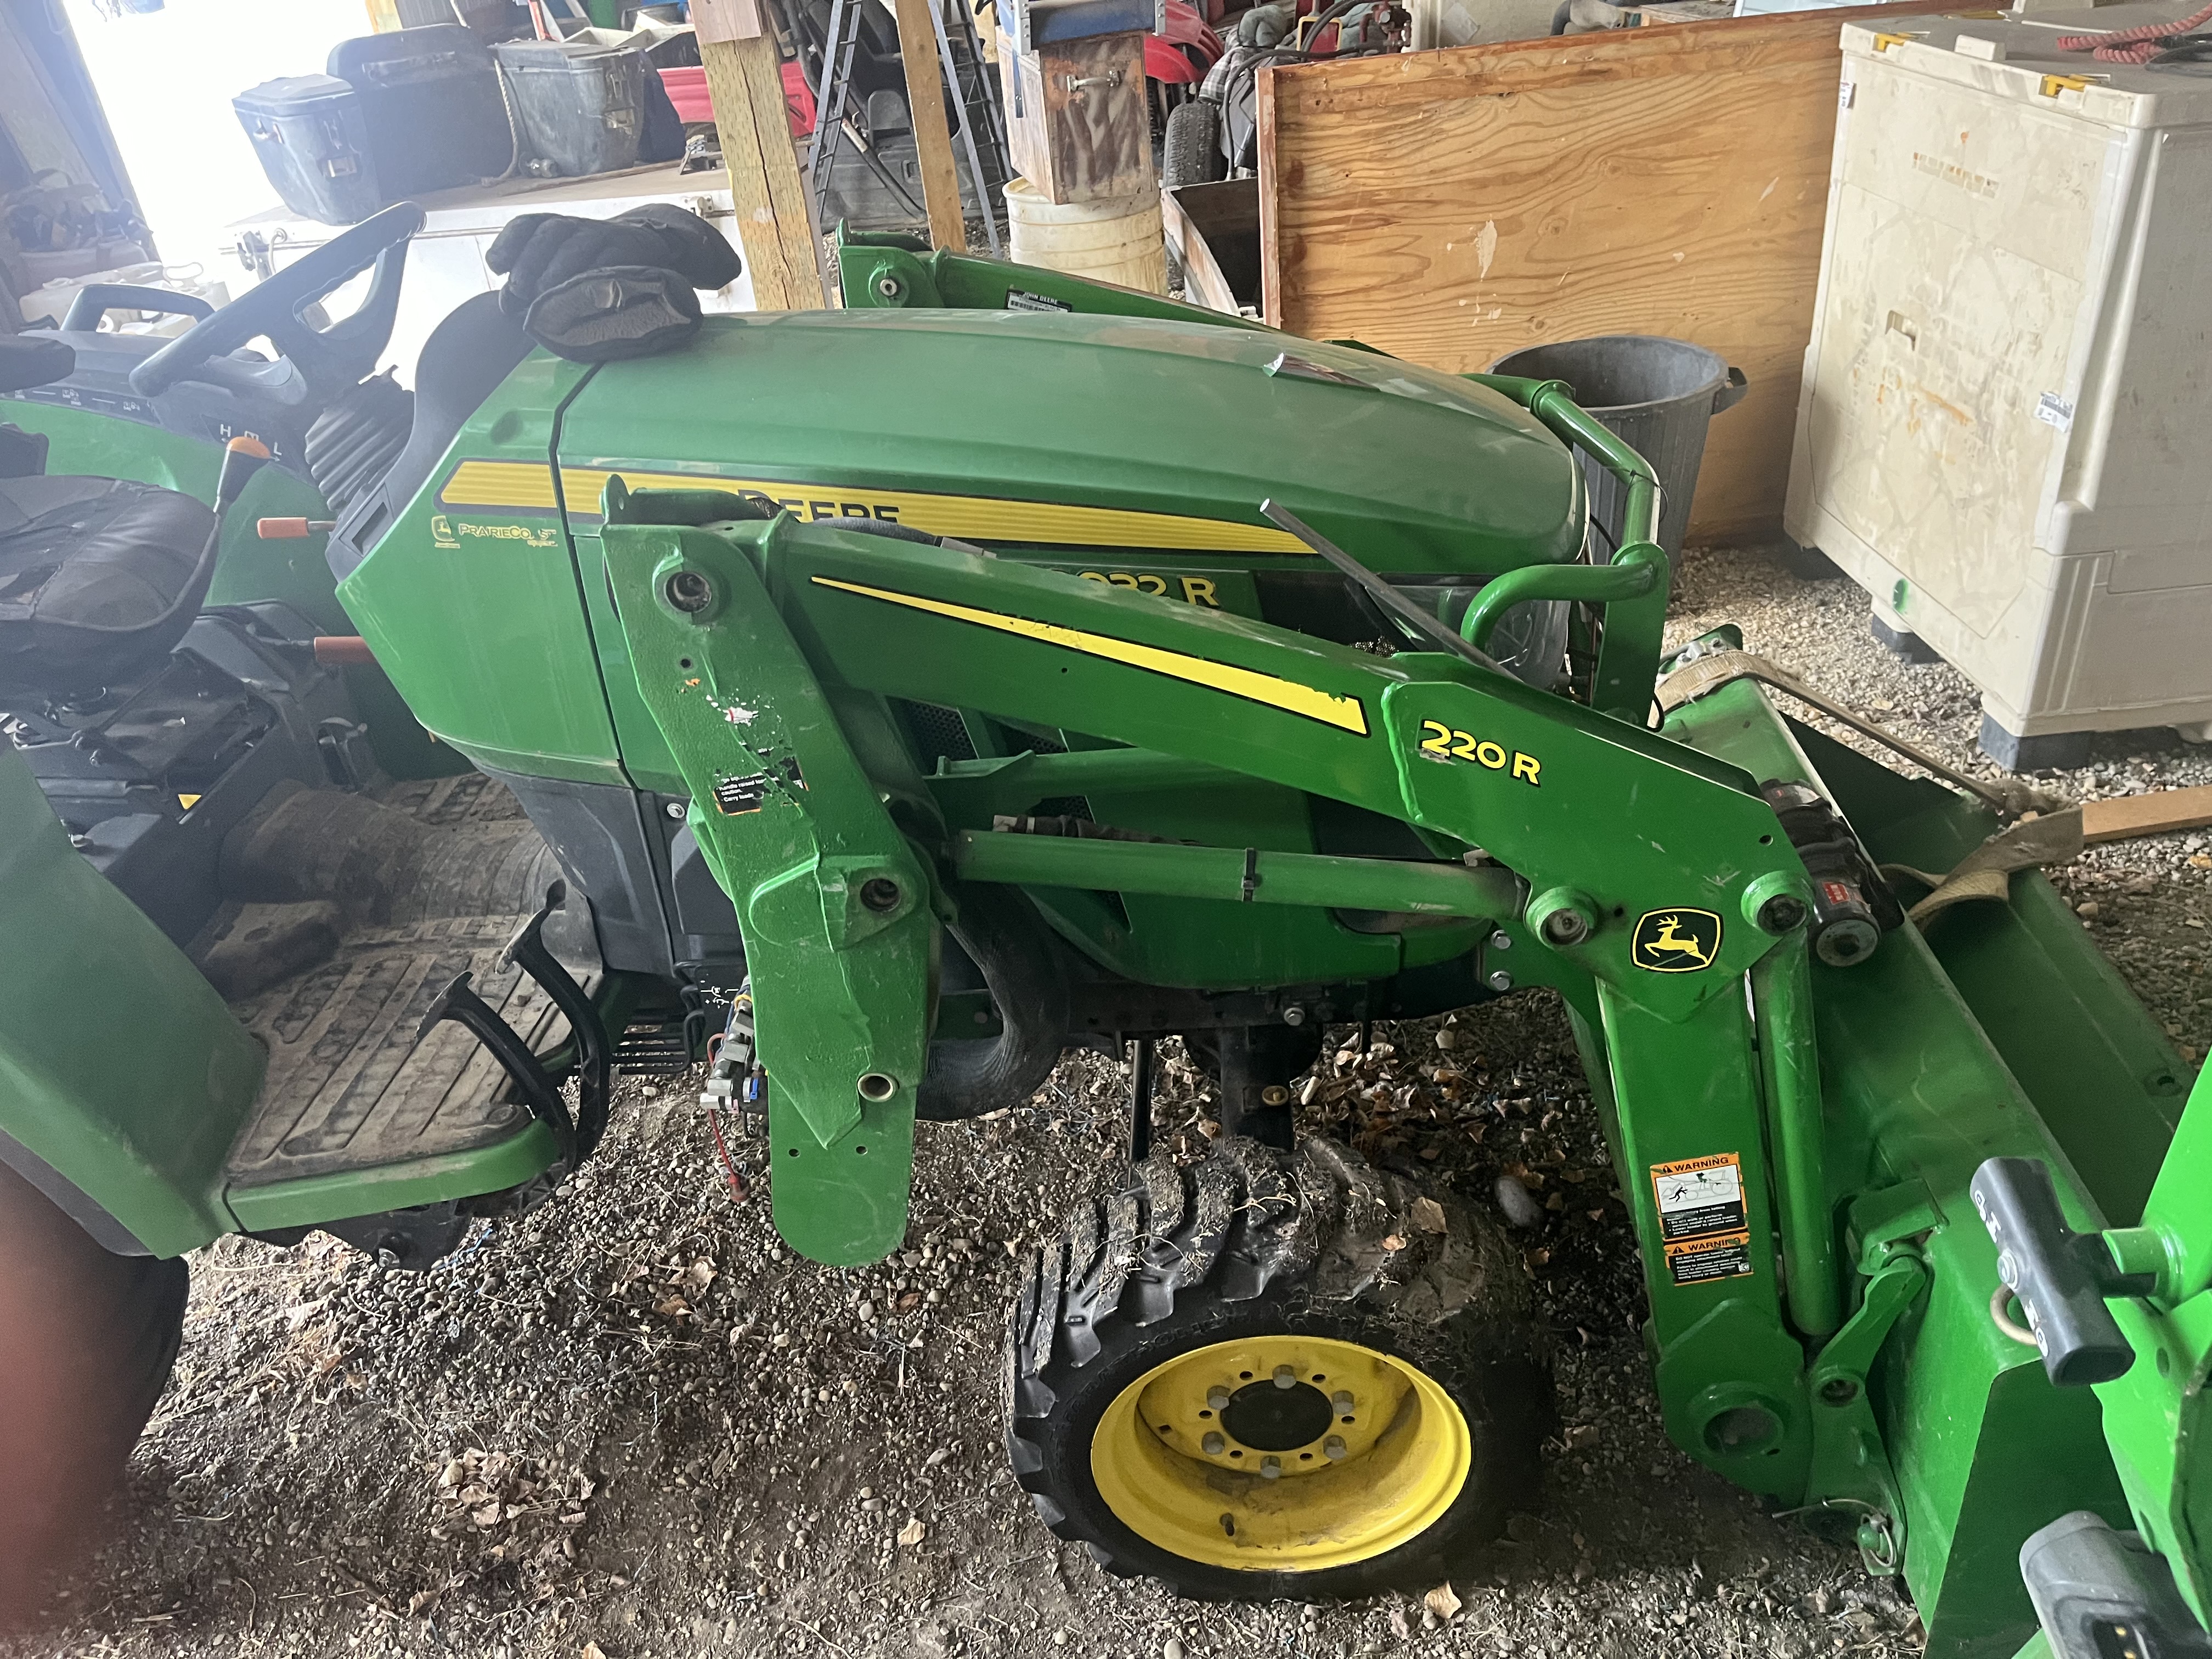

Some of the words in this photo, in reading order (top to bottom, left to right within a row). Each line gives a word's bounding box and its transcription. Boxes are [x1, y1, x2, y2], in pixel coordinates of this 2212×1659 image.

[220, 424, 232, 438] H
[273, 441, 283, 456] L
[1181, 577, 1220, 606] R
[1420, 719, 1508, 770] 220
[1511, 751, 1541, 787] R
[1674, 1157, 1729, 1171] WARNING
